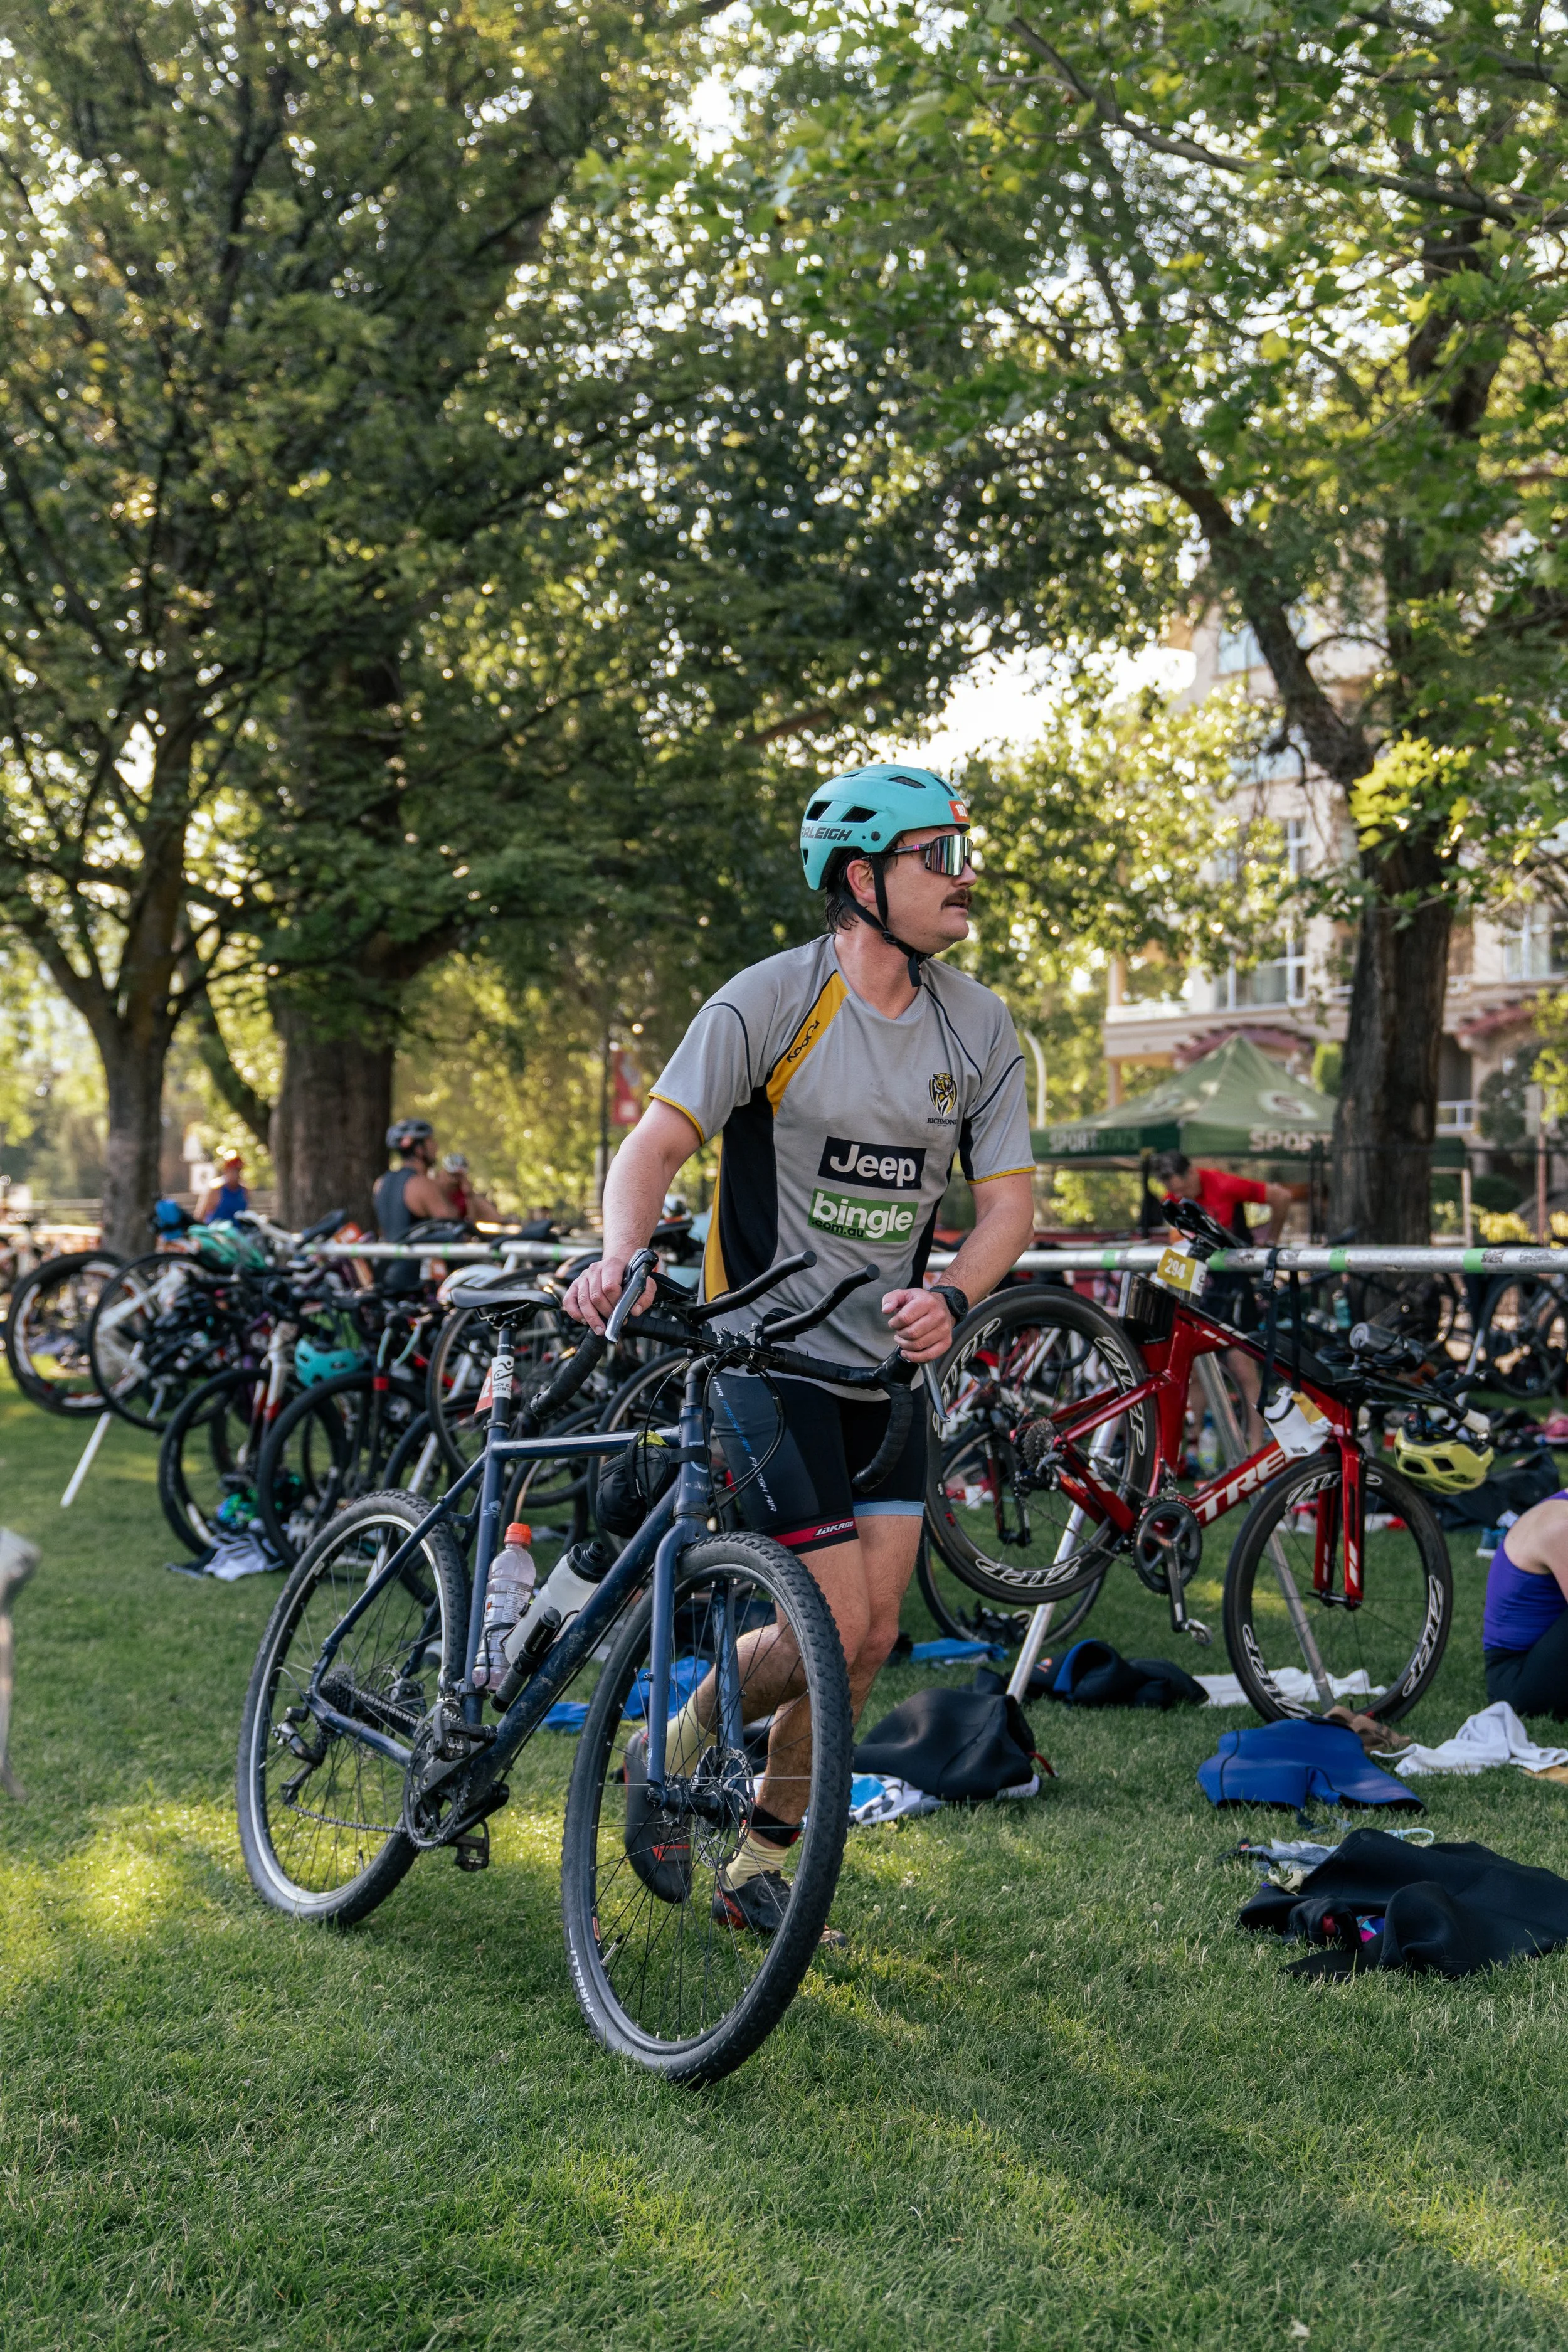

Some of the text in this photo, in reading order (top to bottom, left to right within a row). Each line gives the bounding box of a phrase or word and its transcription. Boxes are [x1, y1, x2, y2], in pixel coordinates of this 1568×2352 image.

[800, 826, 853, 842] RALEIGH
[830, 1143, 916, 1187] Jeep
[811, 1219, 864, 1237] .com.au
[812, 1192, 913, 1239] bingle
[1164, 1257, 1187, 1280] 294
[713, 1382, 724, 1397] AIR
[721, 1400, 743, 1434] FRESH
[739, 1435, 752, 1453] AIR
[764, 1495, 778, 1512] AIR
[1194, 1447, 1286, 1522] TRE
[569, 1949, 595, 2014] PIRELLI
